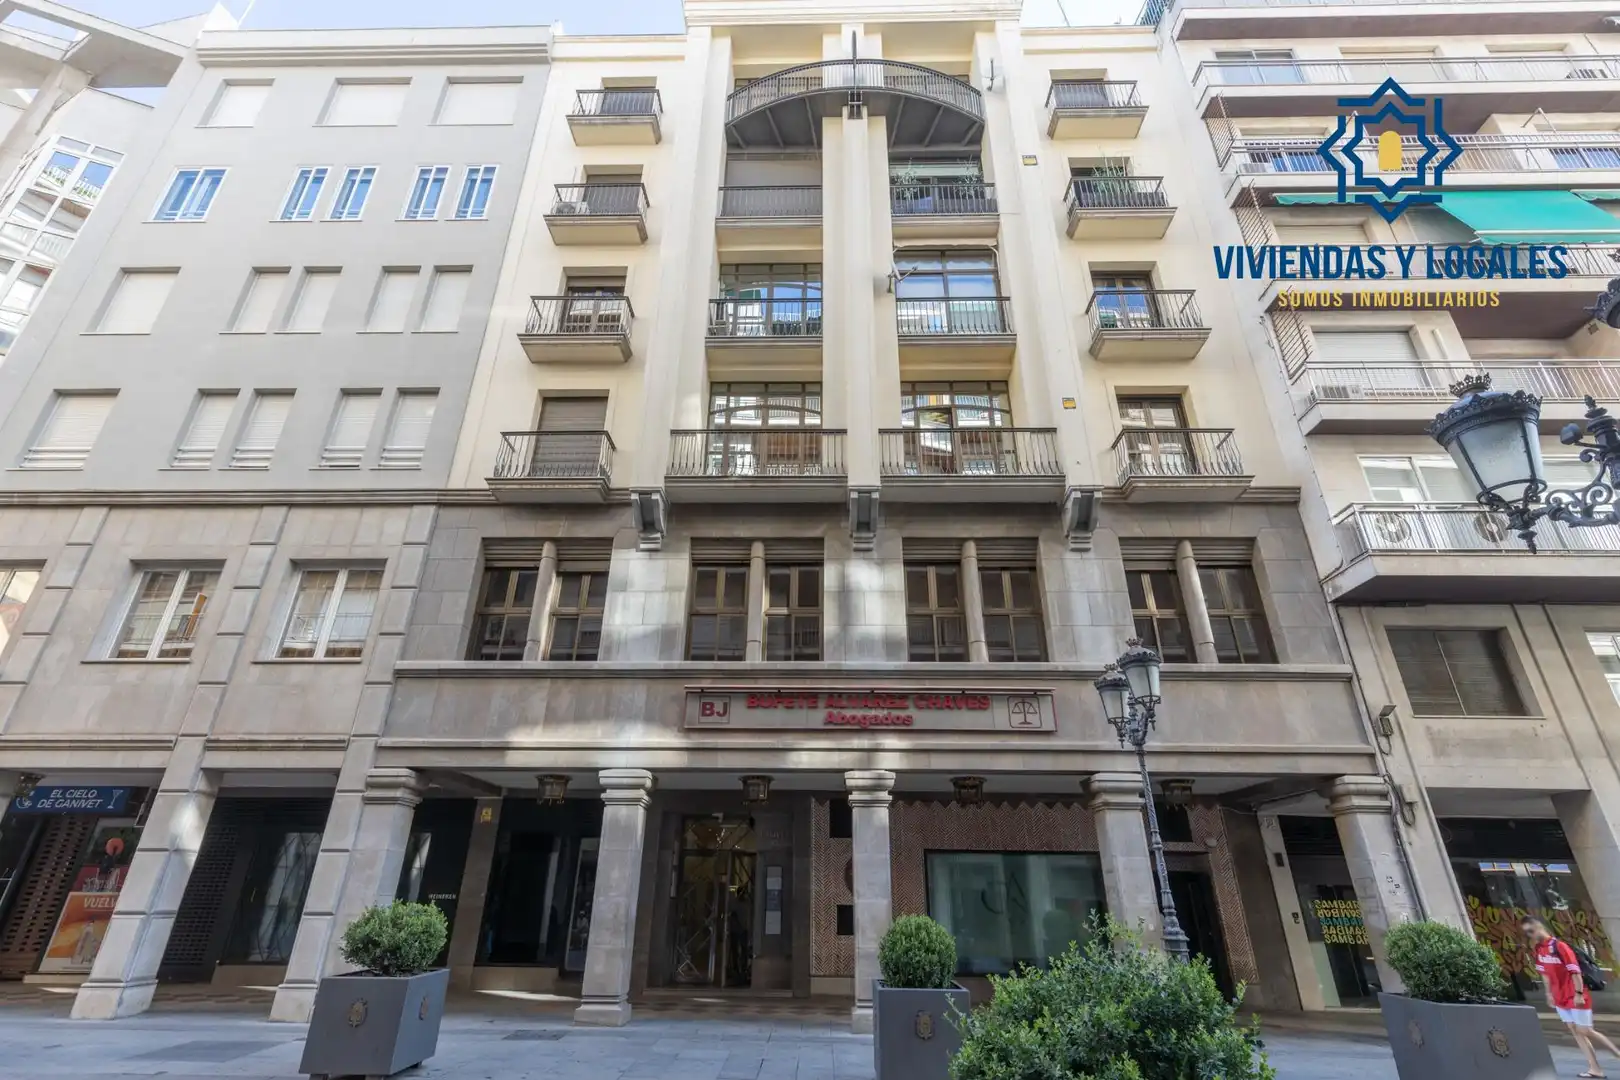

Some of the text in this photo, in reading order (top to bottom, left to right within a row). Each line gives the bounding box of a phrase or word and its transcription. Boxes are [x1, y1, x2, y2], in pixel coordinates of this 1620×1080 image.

[701, 701, 728, 717] BJ
[746, 694, 991, 711] BUFETE ALVAREZ CHAVES
[824, 711, 914, 728] Abogados
[50, 789, 97, 798] EL CIELO
[37, 799, 103, 808] DE GANIVET
